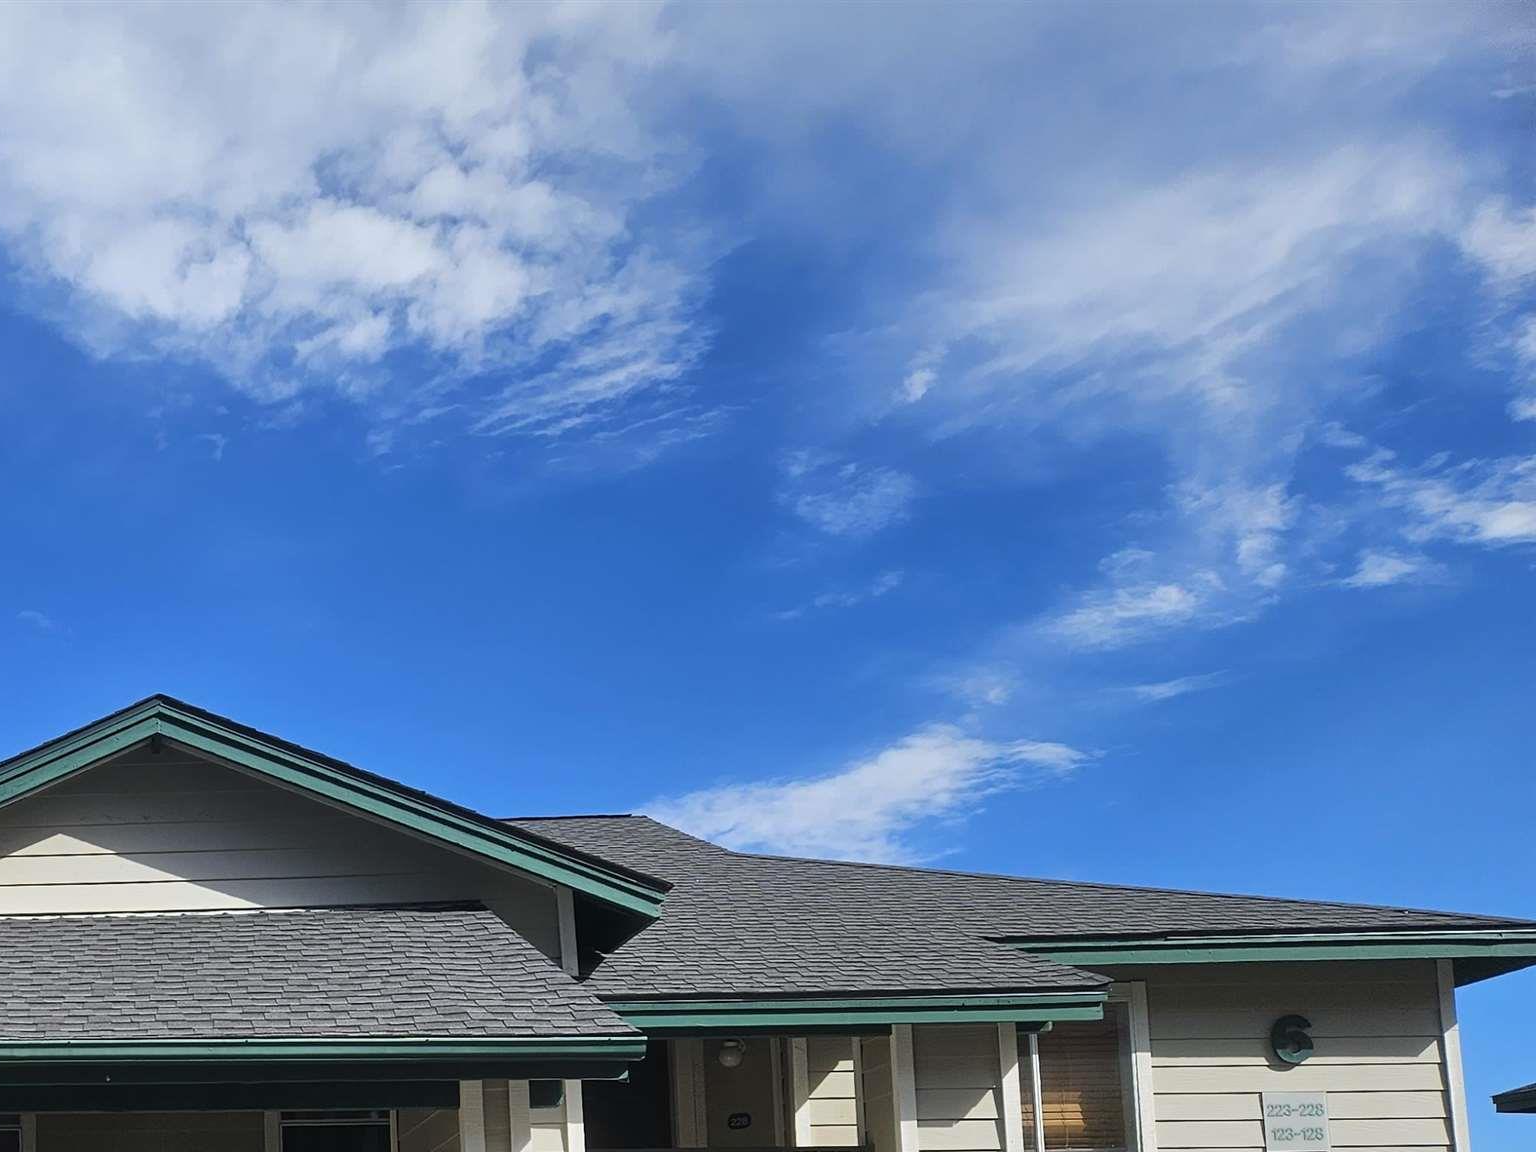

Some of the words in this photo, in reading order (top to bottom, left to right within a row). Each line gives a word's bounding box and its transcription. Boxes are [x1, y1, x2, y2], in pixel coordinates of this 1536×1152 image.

[1271, 1014, 1314, 1063] 6
[1267, 1104, 1324, 1117] 223-228
[1271, 1128, 1324, 1141] 123-128
